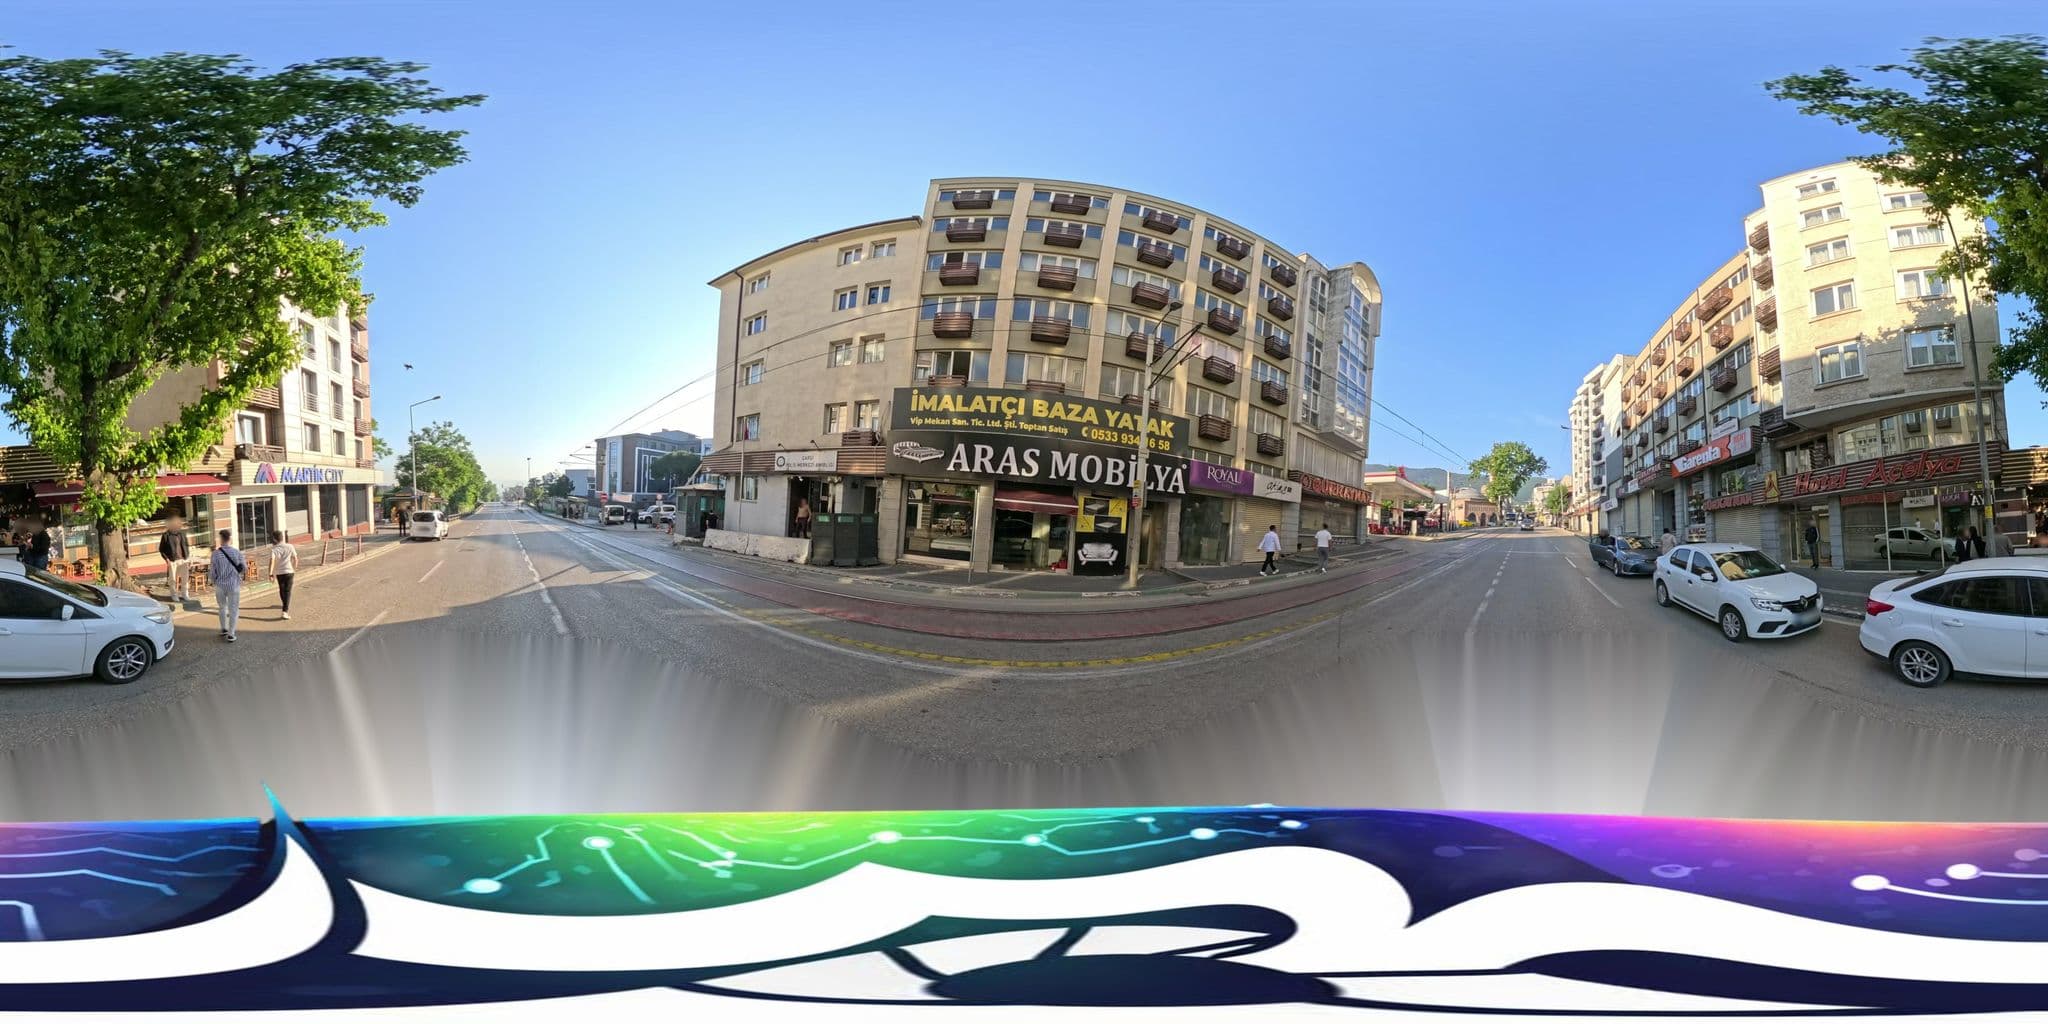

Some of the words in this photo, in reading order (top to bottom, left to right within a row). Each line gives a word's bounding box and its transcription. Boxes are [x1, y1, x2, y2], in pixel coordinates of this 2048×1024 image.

[911, 389, 1025, 419] İMALATÇI
[1032, 399, 1099, 425] BAZA
[1105, 409, 1175, 438] YATAK
[910, 418, 922, 426] Vip
[952, 418, 969, 426] San.
[971, 419, 985, 427] Tic.
[987, 419, 1002, 428] Ltd.
[1004, 420, 1017, 431] Şti.
[1019, 422, 1047, 432] Toptan
[1048, 424, 1068, 436] Satış
[1091, 429, 1118, 442] 0533
[1121, 433, 1141, 446] 934
[1158, 440, 1170, 451] 58
[947, 443, 1040, 477] ARAS
[1049, 450, 1186, 494] MOBİLYA
[1680, 446, 1720, 470] Garenta
[280, 464, 323, 483] MARTİN
[1207, 465, 1241, 485] ROYAL
[1792, 467, 1848, 496] Hotel
